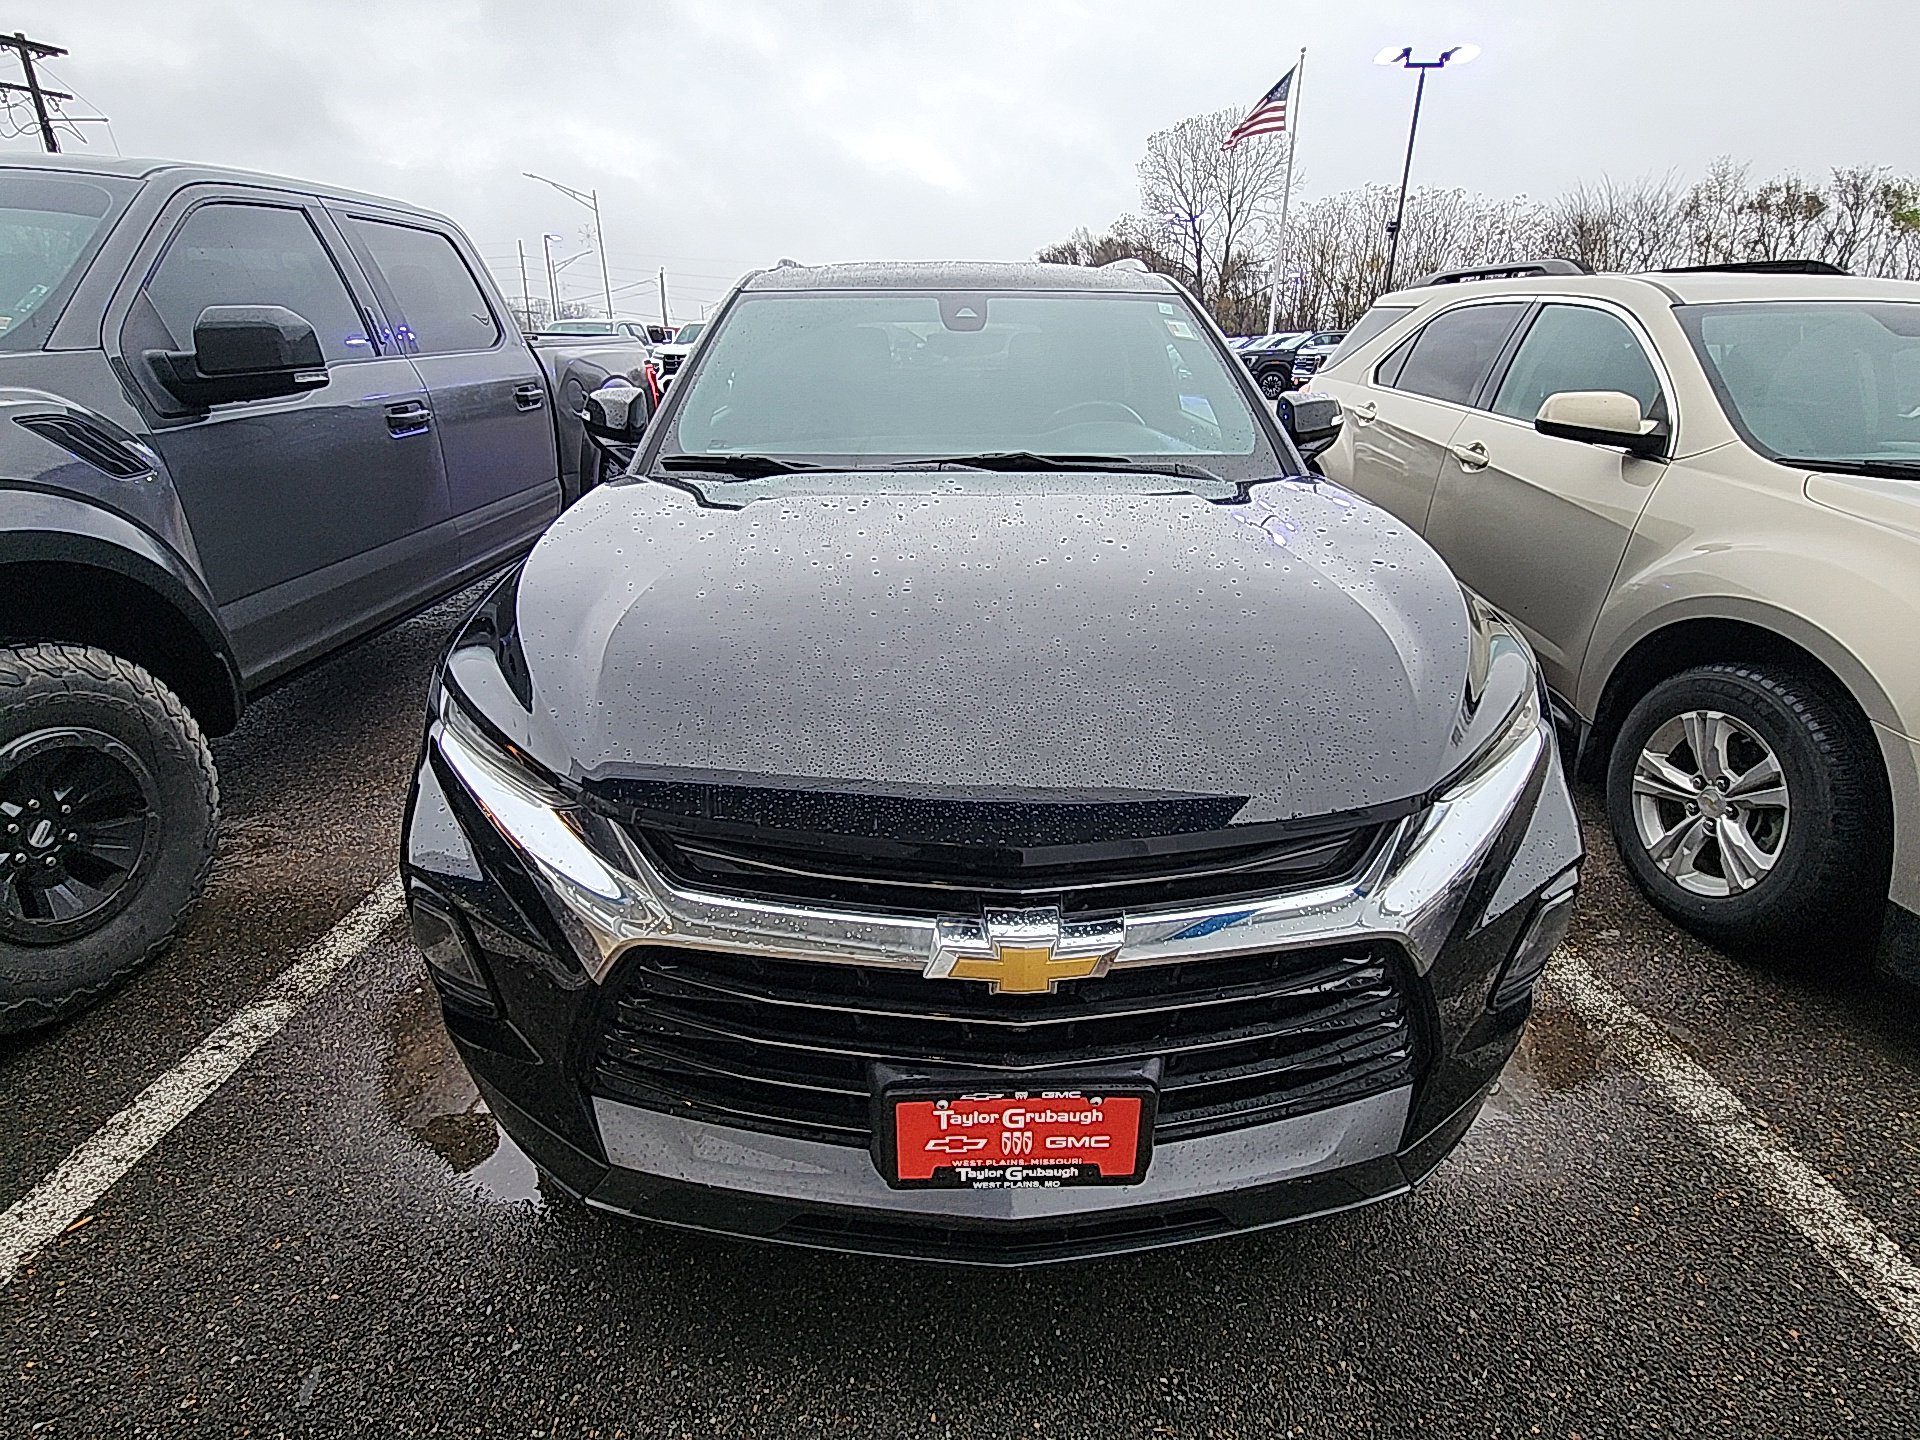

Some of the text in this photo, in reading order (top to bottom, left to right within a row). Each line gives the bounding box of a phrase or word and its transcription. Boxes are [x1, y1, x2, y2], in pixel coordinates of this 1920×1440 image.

[1042, 1091, 1082, 1099] GMC
[932, 1108, 1103, 1130] Taylor Grubaugh
[1045, 1136, 1110, 1148] GMC
[955, 1166, 1079, 1181] Taylor Grubaugh
[973, 1181, 1001, 1189] WEST
[1044, 1180, 1060, 1188] MO
